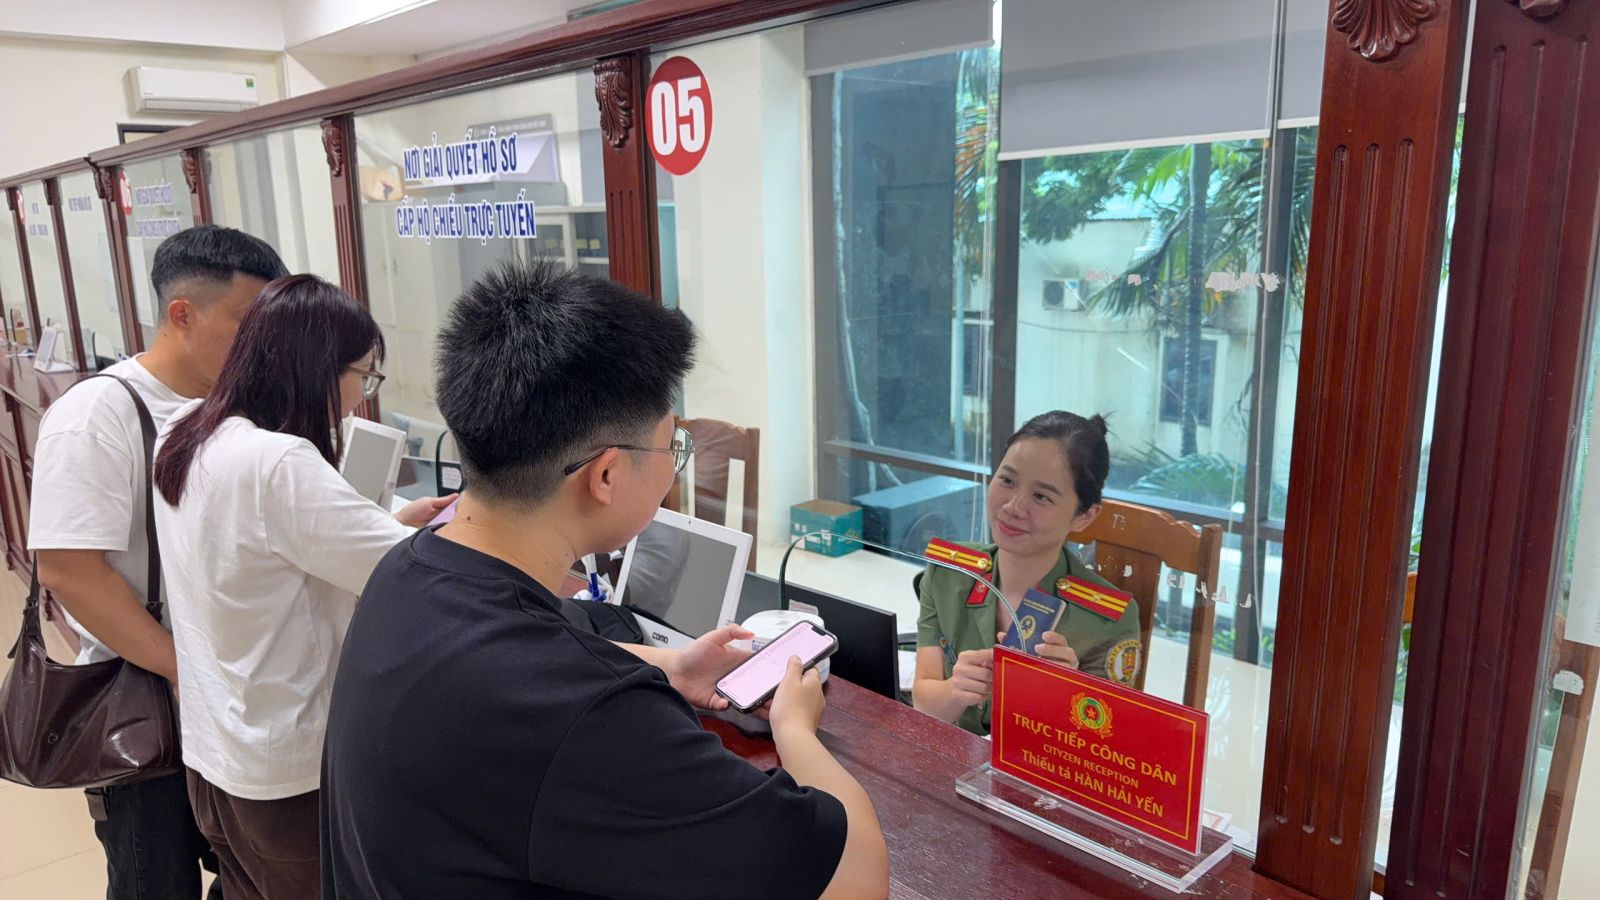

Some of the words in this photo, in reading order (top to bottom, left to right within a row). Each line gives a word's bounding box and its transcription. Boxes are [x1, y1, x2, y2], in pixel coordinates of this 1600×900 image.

[651, 75, 706, 156] 05
[403, 146, 421, 179] NƠI
[423, 132, 444, 178] GIẢI
[445, 128, 478, 181] QUYẾT
[480, 126, 498, 174] HỒ
[500, 132, 517, 173] SƠ
[397, 195, 414, 237] CẤP
[416, 199, 431, 244] HỘ
[432, 193, 464, 238] CHIẾU
[464, 200, 494, 244] TRỰC
[495, 188, 536, 238] TUYẾN
[1013, 712, 1052, 738] TRỰC
[1055, 728, 1087, 750] TIẾP
[1090, 743, 1136, 770] CÔNG
[1141, 761, 1177, 786] DÂN
[1043, 743, 1081, 766] CITYZEN
[1083, 759, 1139, 788] RECEPTION
[1021, 748, 1056, 773] Thiếu
[1058, 765, 1071, 780] tá
[1074, 770, 1104, 793] HÀN
[1107, 784, 1131, 805] HẢI
[1135, 796, 1164, 818] YẾN
